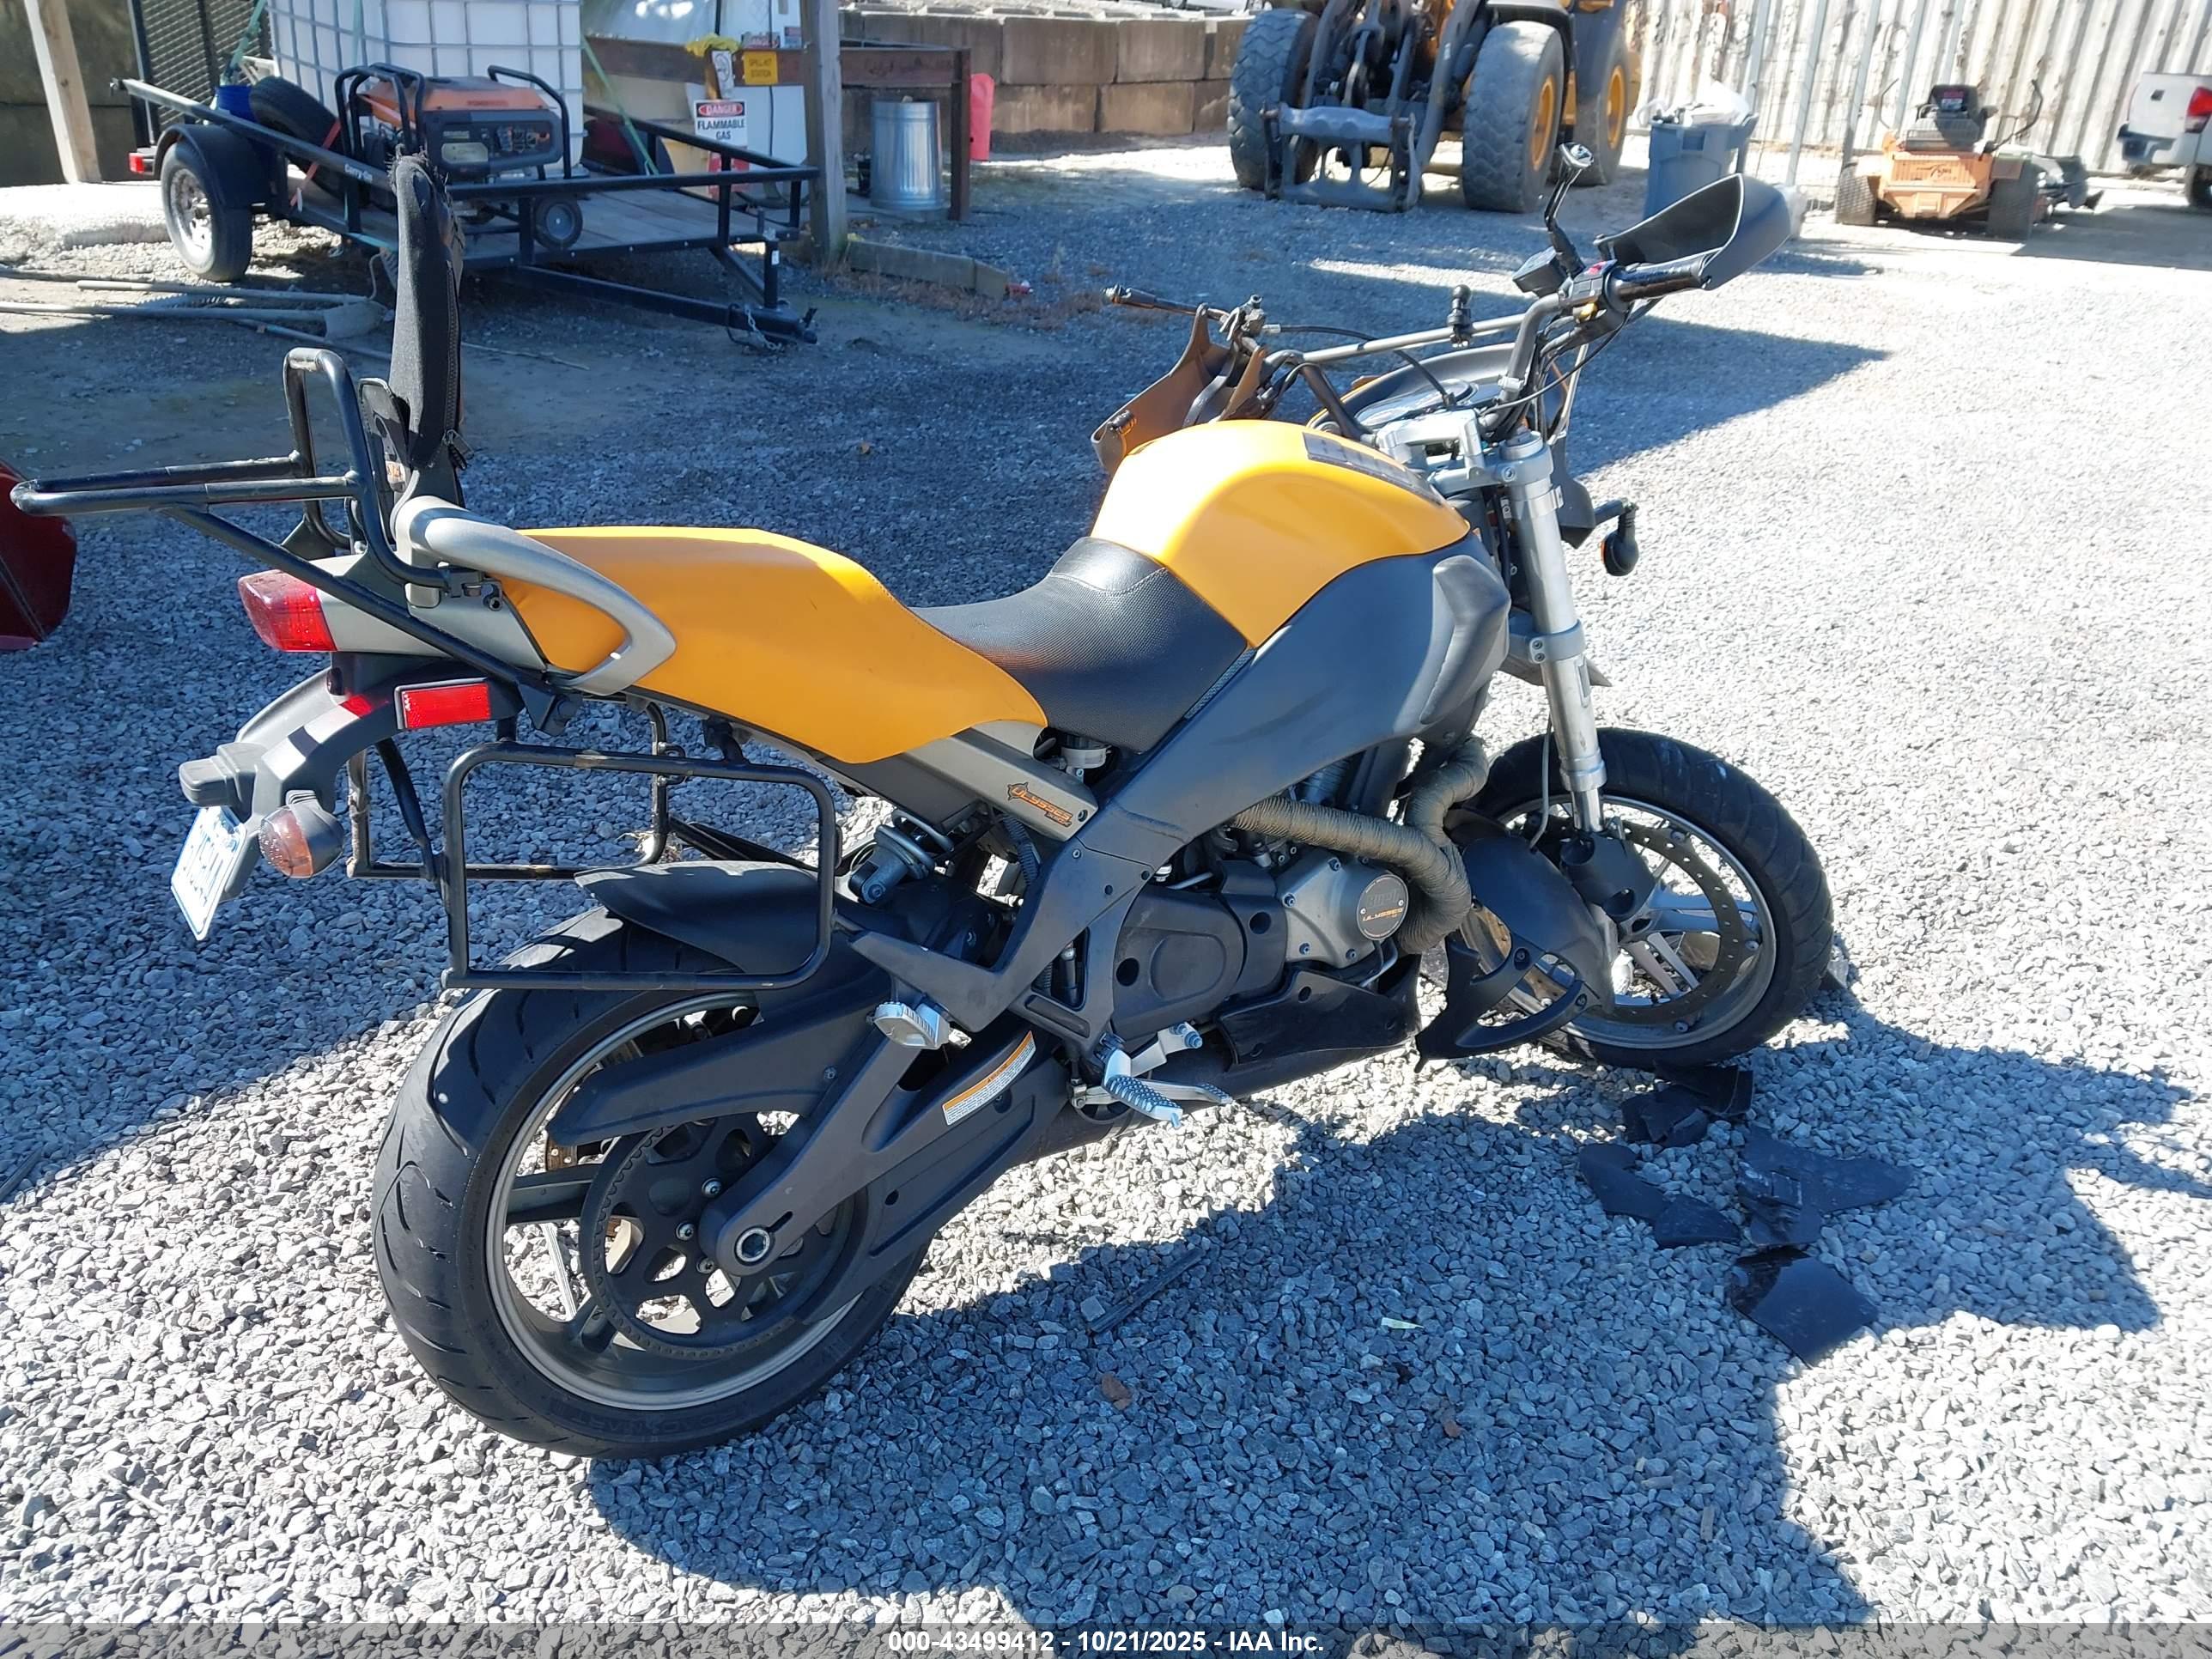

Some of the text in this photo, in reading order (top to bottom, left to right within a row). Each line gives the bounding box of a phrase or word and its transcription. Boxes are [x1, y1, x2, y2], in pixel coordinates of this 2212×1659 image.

[706, 104, 737, 114] DANGER
[697, 118, 745, 130] FLAMMABLE
[715, 131, 732, 140] GAS
[1012, 787, 1073, 823] ULYSSES
